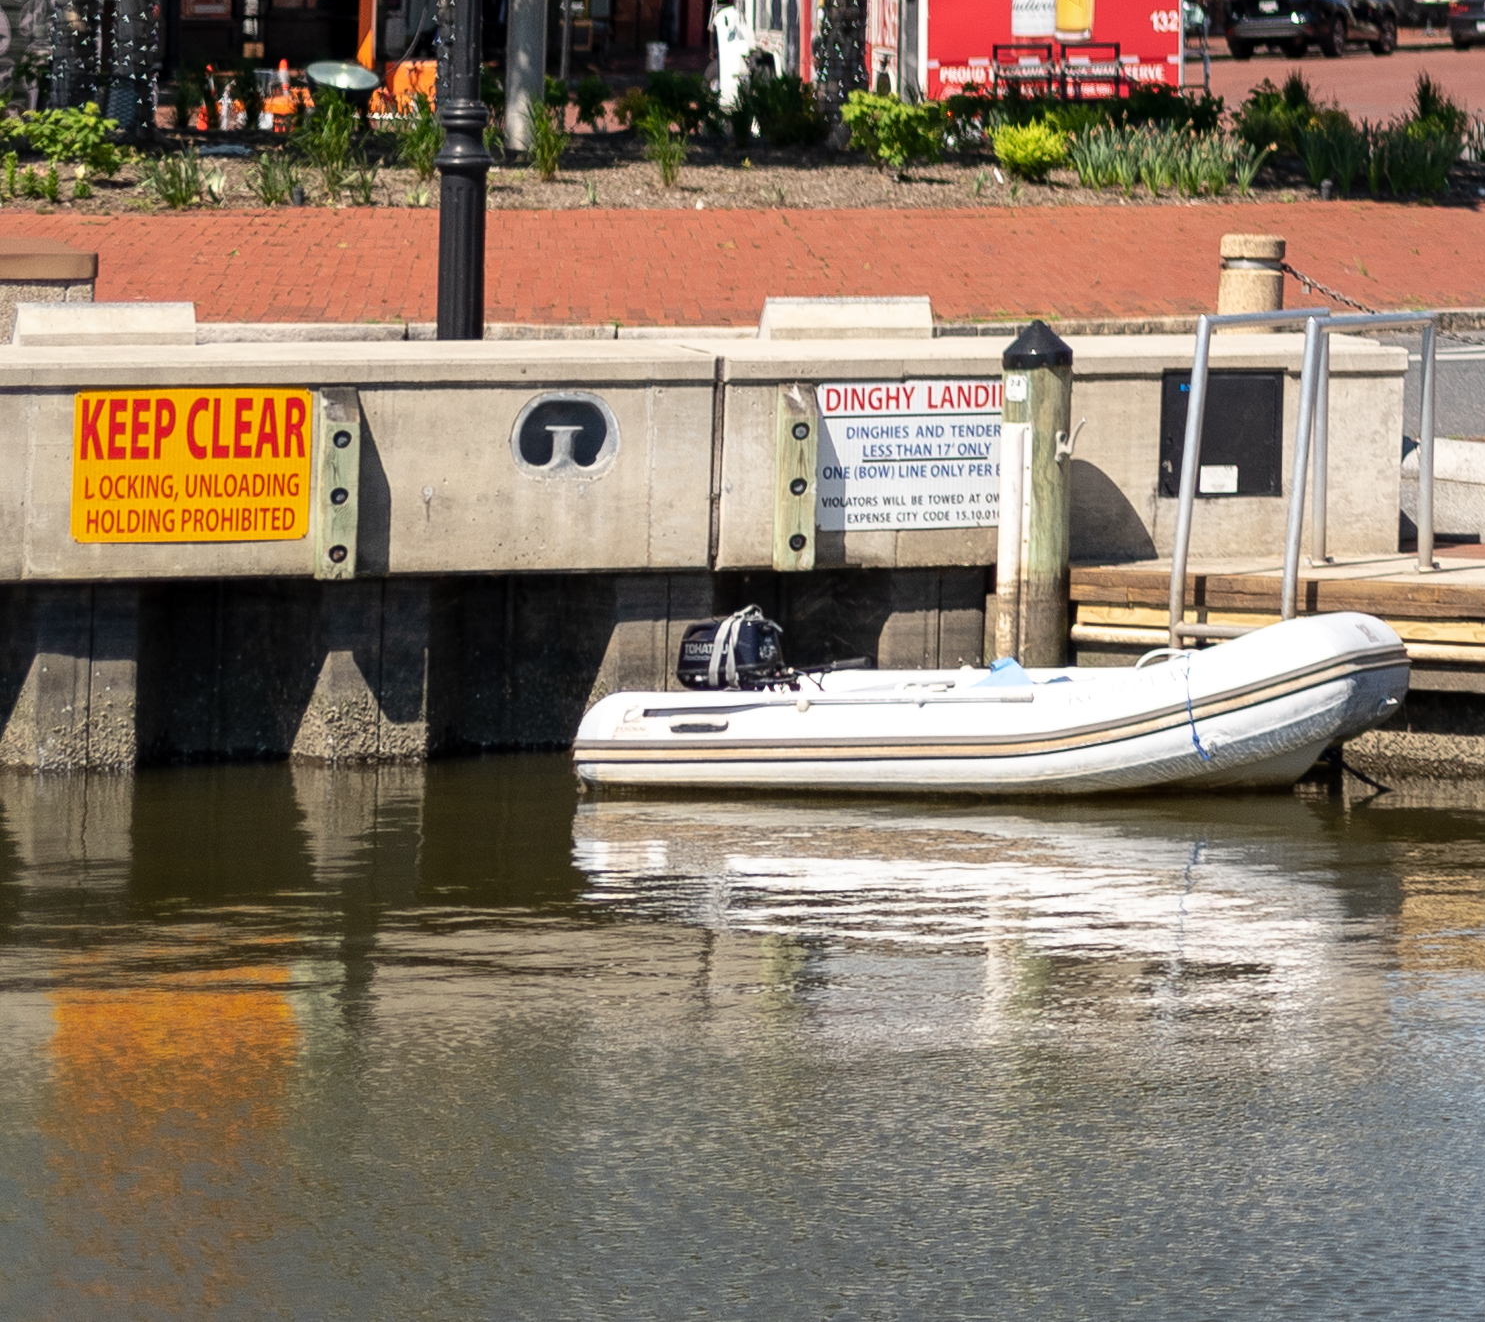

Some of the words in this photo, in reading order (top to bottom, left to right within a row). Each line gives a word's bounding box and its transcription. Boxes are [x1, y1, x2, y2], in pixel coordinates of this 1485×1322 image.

[1150, 10, 1179, 32] 132
[826, 385, 915, 412] DINGHY
[927, 384, 1002, 409] LANDI
[80, 397, 177, 461] KEEP
[186, 397, 307, 460] CLEAR
[846, 425, 909, 440] DINGHIES
[915, 425, 945, 438] AND
[862, 443, 893, 458] LESS
[896, 443, 932, 457] THAN
[957, 442, 992, 456] ONLY
[822, 465, 851, 480] ONE
[854, 464, 896, 481] (BOW)
[898, 464, 927, 478] LINE
[930, 463, 966, 478] ONLY
[968, 463, 992, 477] PER
[185, 473, 300, 499] UNLOADING
[821, 496, 878, 508] VIOLATORS
[882, 495, 906, 506] WILL
[911, 494, 923, 505] BE
[928, 493, 964, 505] TOWED
[968, 493, 981, 504] AT
[86, 509, 175, 534] HOLDING
[181, 507, 296, 532] PROHIBITED
[847, 512, 892, 524] EXPENSE
[896, 511, 918, 523] CITY
[923, 510, 950, 522] CODE
[684, 642, 729, 655] TOHATU
